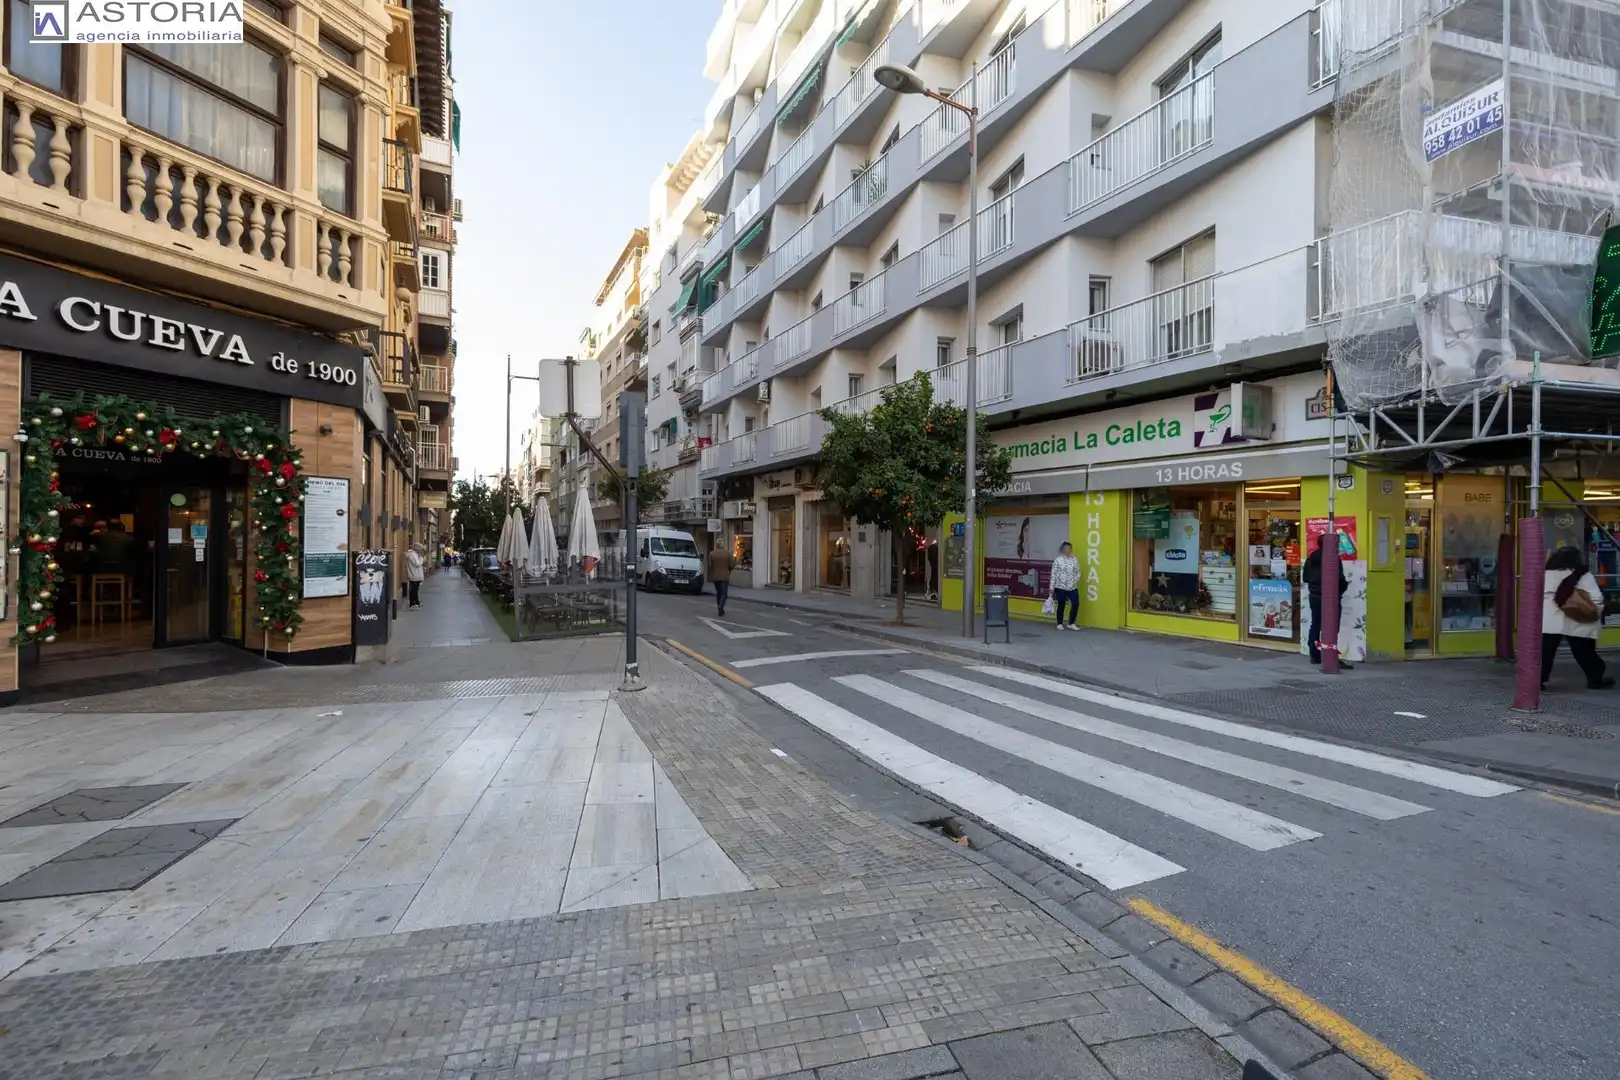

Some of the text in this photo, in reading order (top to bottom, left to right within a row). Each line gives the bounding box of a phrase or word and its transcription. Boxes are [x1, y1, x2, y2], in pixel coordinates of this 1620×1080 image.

[1425, 105, 1502, 155] 958 42 01 45
[0, 281, 357, 387] A CUEVA de 1900
[1310, 402, 1327, 414] CIS
[1074, 431, 1098, 451] La
[1105, 417, 1182, 446] Caleta
[72, 448, 126, 461] CUEVA
[1155, 461, 1243, 484] 13 HORAS
[1085, 491, 1105, 602] 13 HORAS
